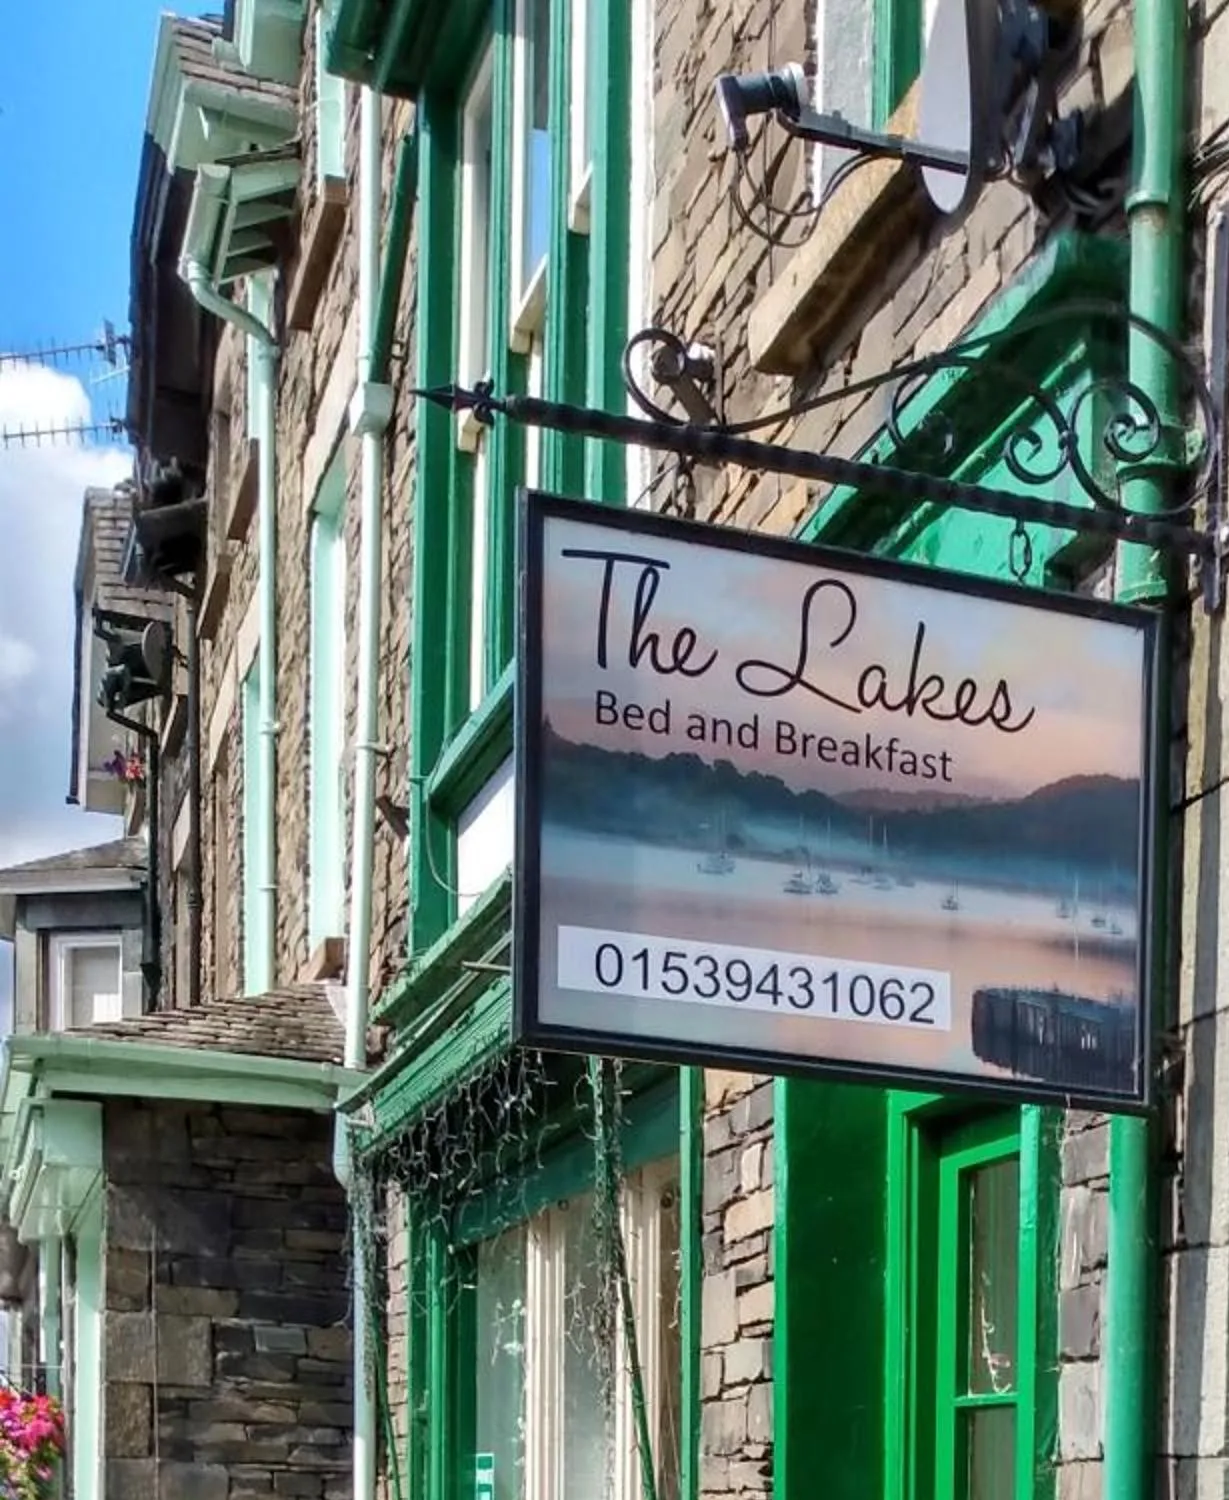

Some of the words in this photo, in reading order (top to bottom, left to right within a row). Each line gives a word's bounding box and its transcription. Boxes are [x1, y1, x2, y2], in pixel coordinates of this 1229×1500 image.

[562, 549, 718, 677] The
[736, 579, 1035, 732] Lakes
[595, 690, 670, 736] Bed
[686, 713, 758, 750] and
[775, 720, 953, 782] Breakfast
[594, 943, 935, 1024] 01539431062
